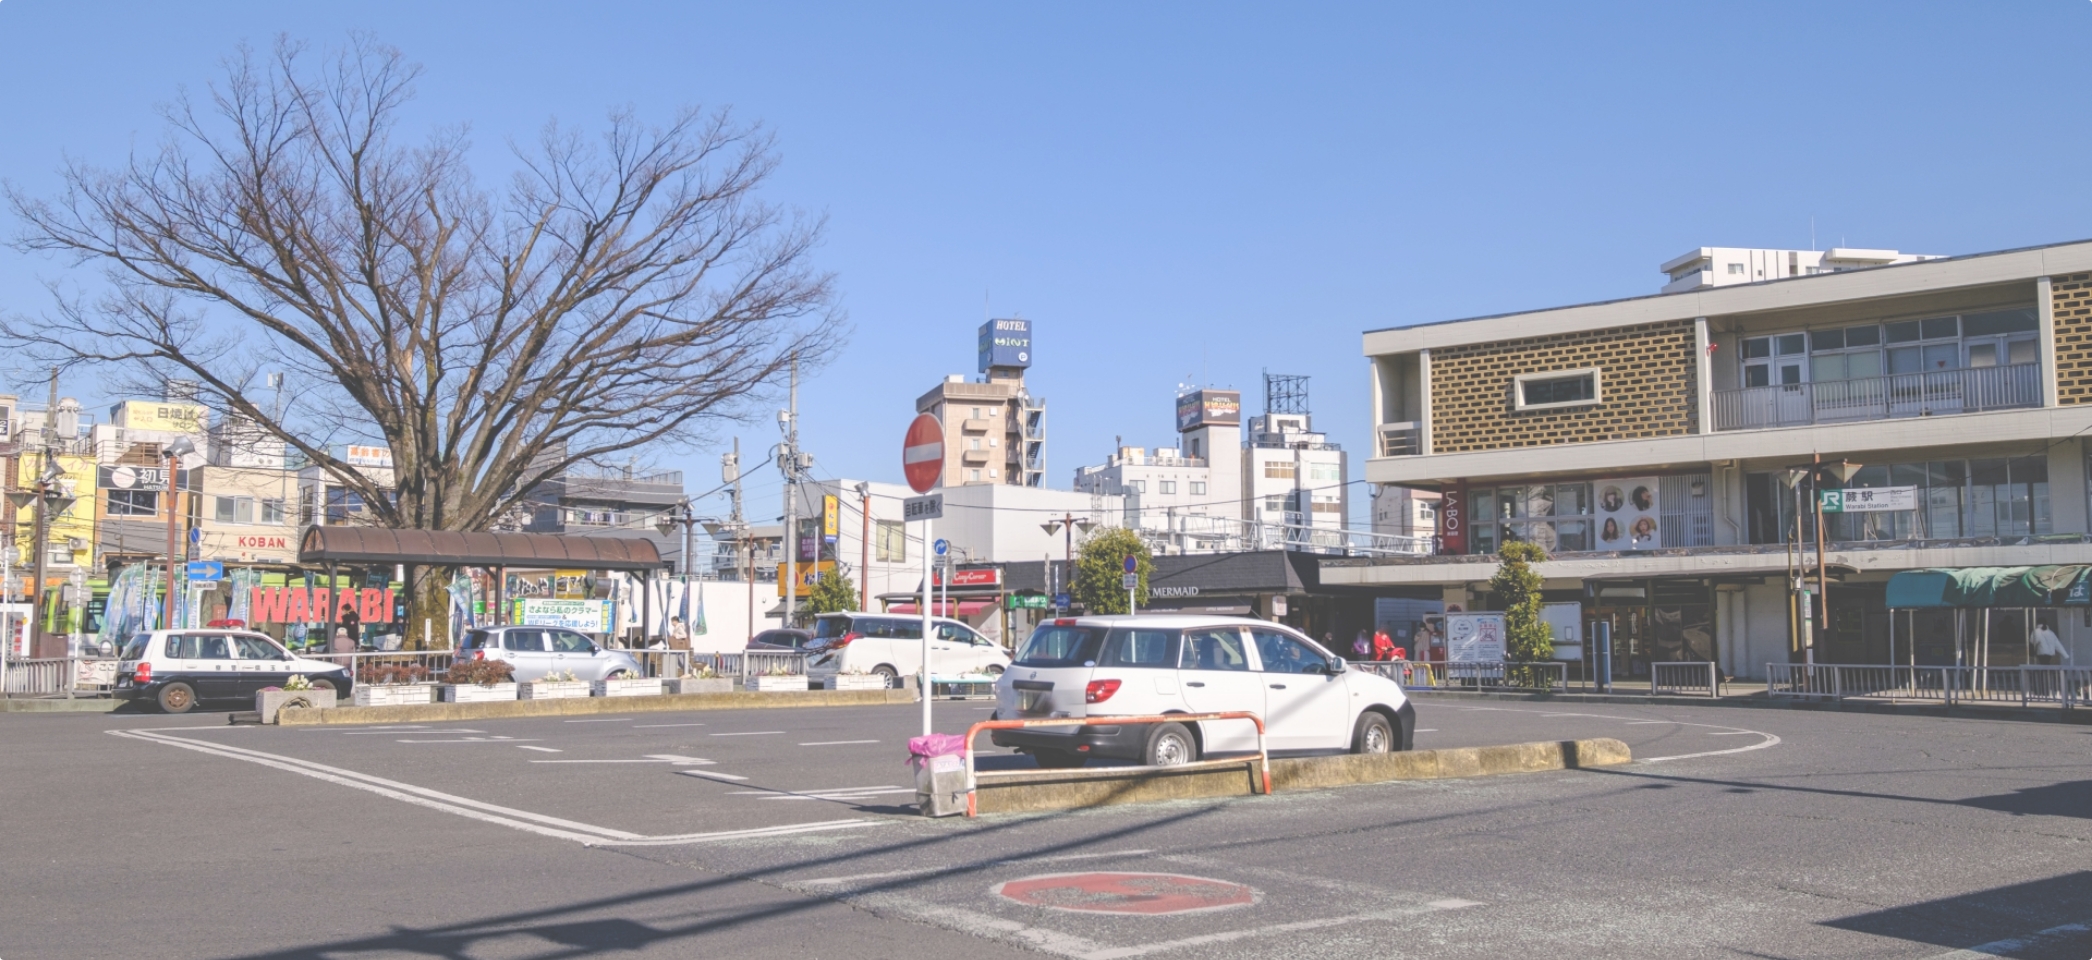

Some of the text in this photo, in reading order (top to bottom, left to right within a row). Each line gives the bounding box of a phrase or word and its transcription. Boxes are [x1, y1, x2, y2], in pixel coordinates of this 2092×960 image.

[996, 320, 1027, 332] HOTEL
[1821, 492, 1840, 505] JR
[905, 500, 942, 517] 自転車を除く
[238, 536, 286, 548] KOBAN
[1152, 586, 1199, 597] MERMAID
[252, 587, 394, 623] WARABI
[528, 605, 598, 614] さよなら私のクラマー
